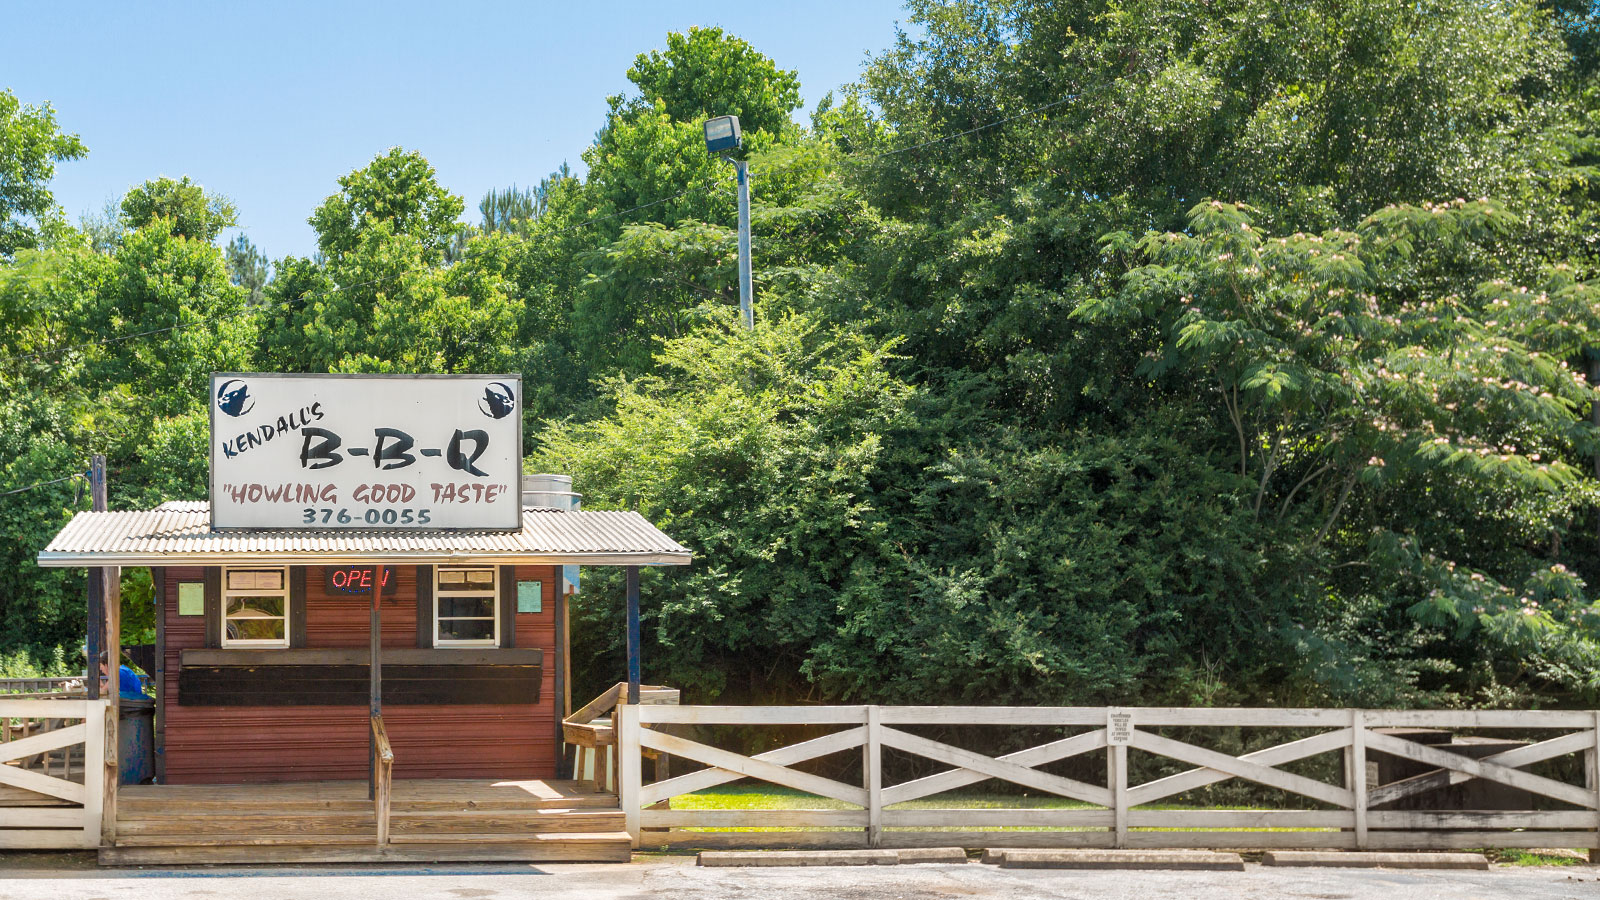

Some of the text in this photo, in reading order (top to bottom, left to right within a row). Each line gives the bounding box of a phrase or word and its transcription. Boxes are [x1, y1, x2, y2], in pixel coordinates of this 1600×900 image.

[223, 401, 325, 459] KENDALL'S
[300, 427, 490, 477] B-B-Q
[223, 482, 507, 504] "HOWLING GOOD TASTE"
[303, 508, 431, 524] 376-0055
